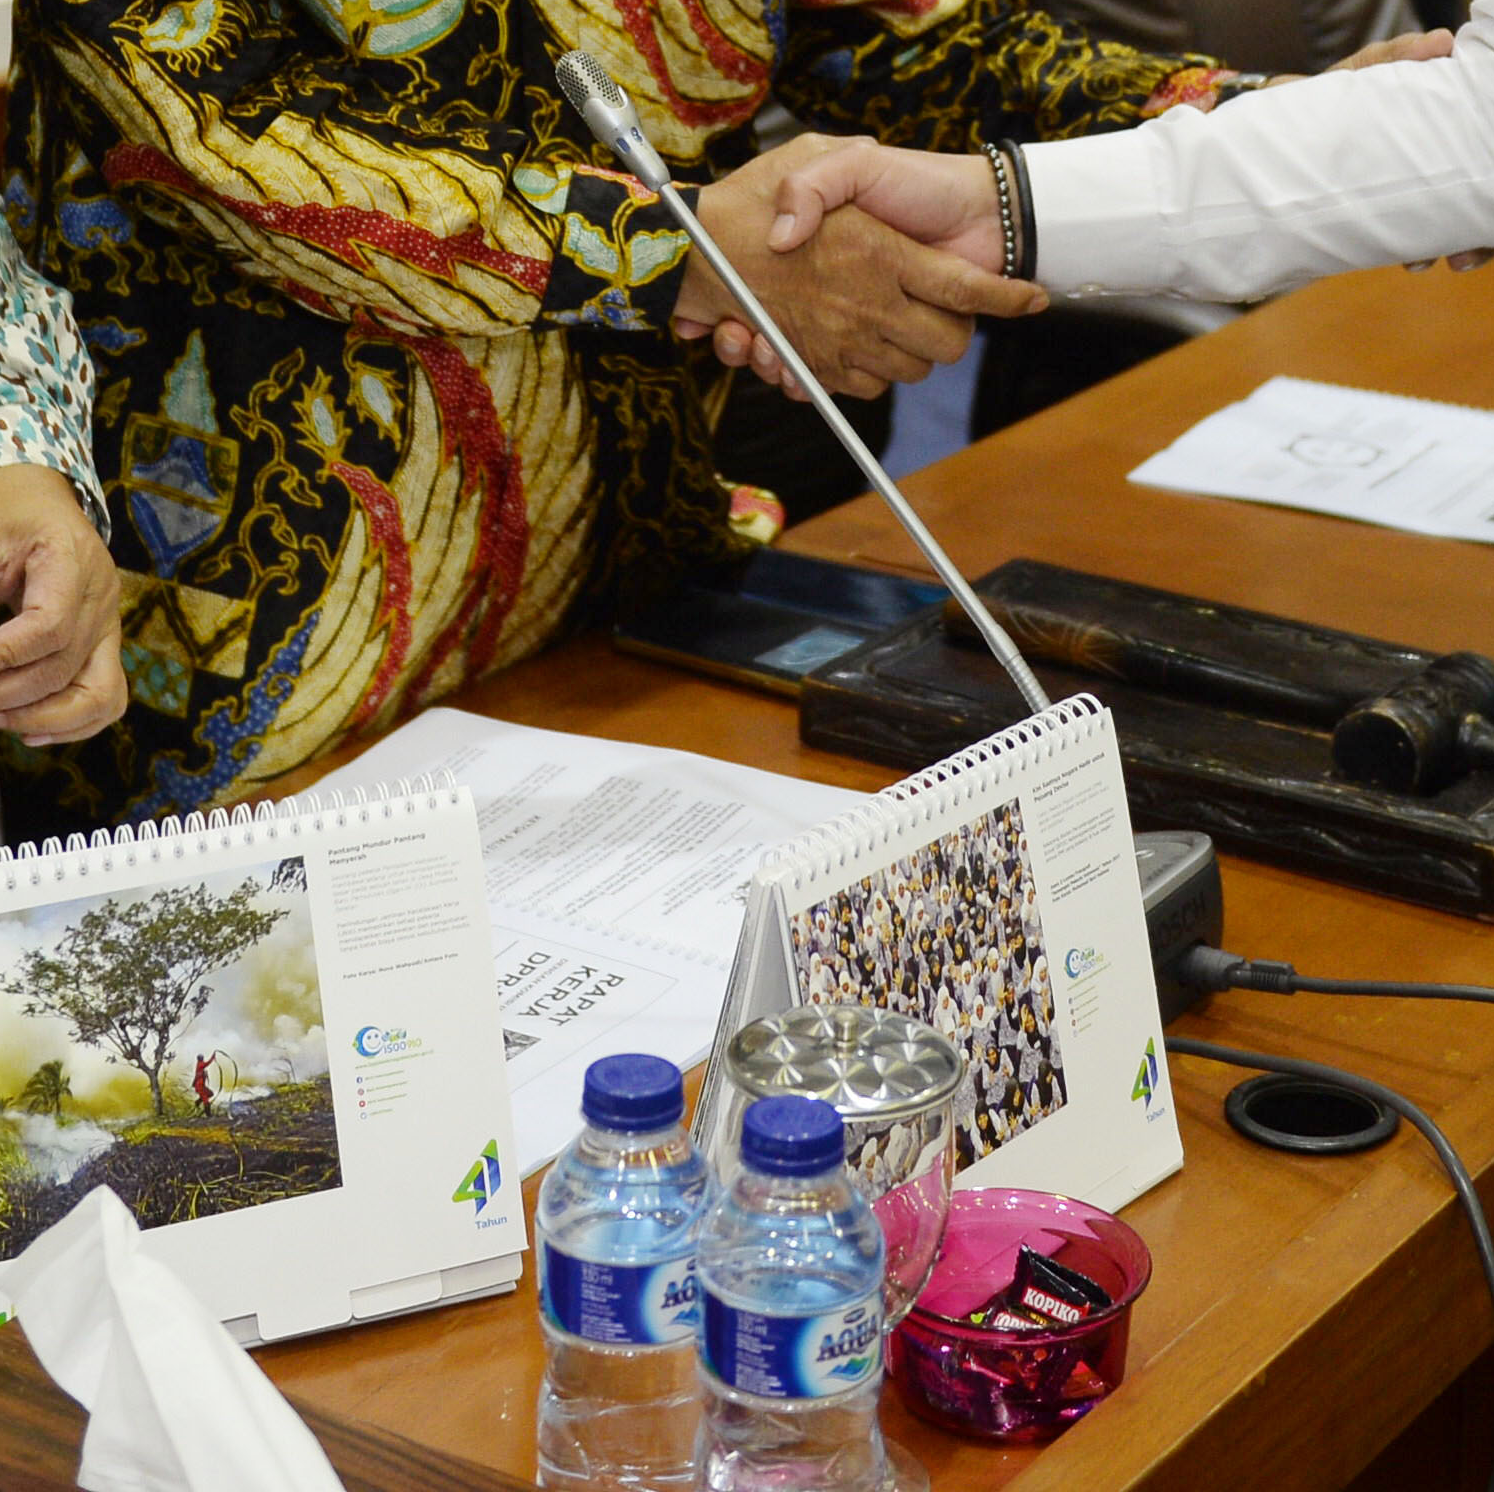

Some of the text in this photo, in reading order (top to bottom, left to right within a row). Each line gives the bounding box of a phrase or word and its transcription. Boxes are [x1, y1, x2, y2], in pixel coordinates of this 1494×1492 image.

[328, 832, 426, 856] Pantang Mundur Pantang
[329, 854, 367, 866] Menyerah
[518, 965, 599, 1017] KERJA
[548, 973, 625, 1026] RAPAT
[475, 1216, 507, 1230] Tahun
[1023, 1288, 1080, 1324] KOPIKO
